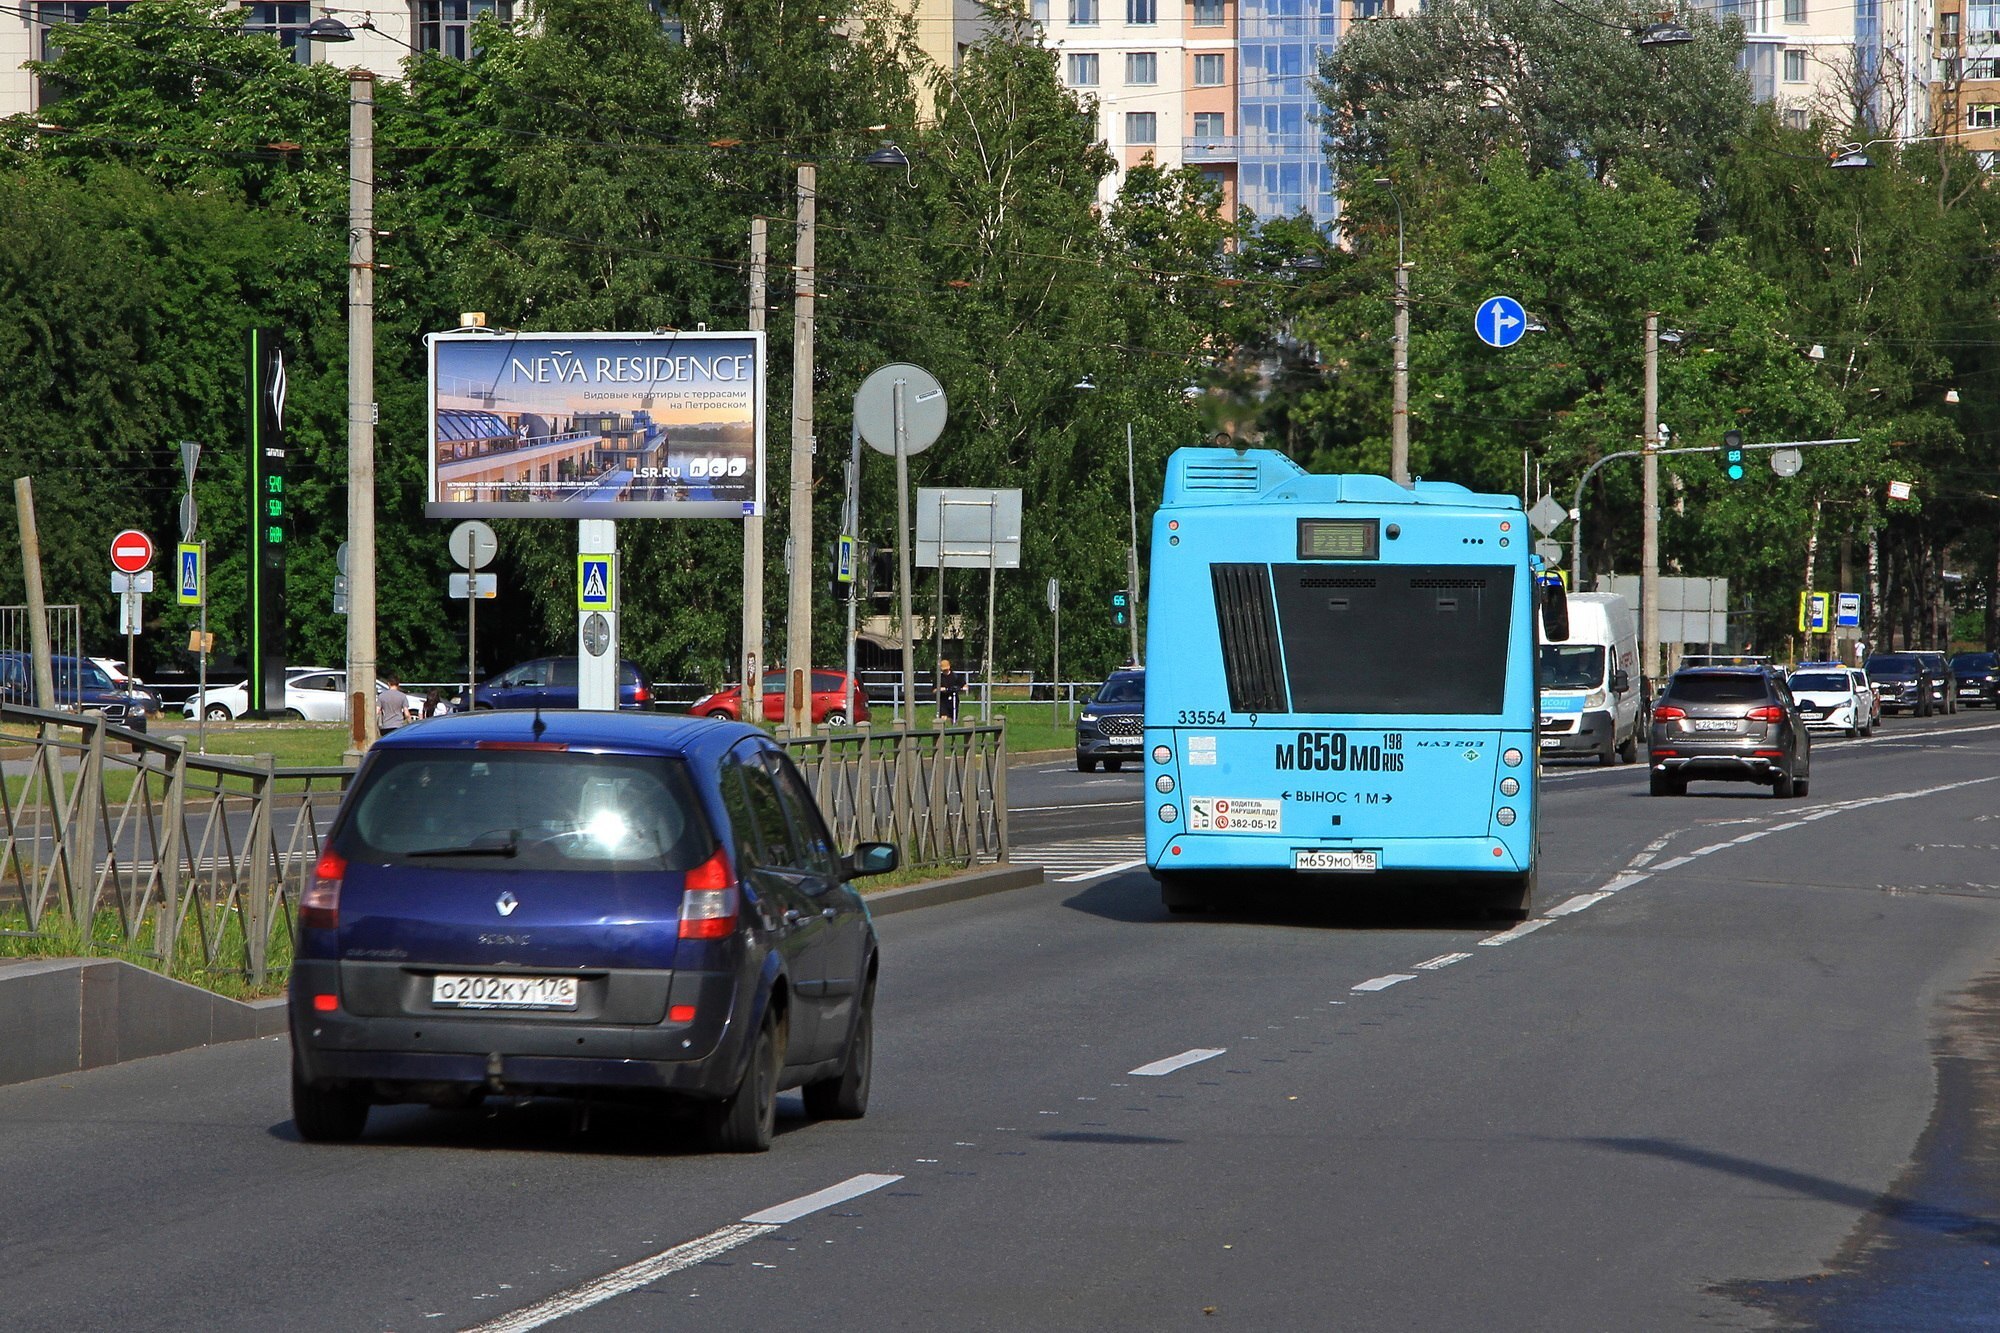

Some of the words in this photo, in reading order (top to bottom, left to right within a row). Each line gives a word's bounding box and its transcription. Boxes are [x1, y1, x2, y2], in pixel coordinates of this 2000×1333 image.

[584, 391, 629, 400] Видовые
[632, 392, 681, 401] квартиры
[692, 391, 747, 400] террасами
[685, 401, 747, 411] Петровском
[633, 467, 681, 478] LSR.RU
[1114, 595, 1125, 606] 65
[1178, 710, 1226, 725] 33554
[1383, 733, 1402, 750] 198
[1382, 753, 1404, 772] RUS
[1296, 790, 1347, 803] ВЫНОС
[1354, 792, 1361, 804] 1
[1366, 793, 1379, 804] М
[1230, 808, 1261, 816] НАРУШИЛ
[1261, 809, 1279, 817] ПДД?
[1230, 819, 1277, 829] 382-05-12
[1353, 854, 1374, 864] 198
[537, 978, 571, 997] 178
